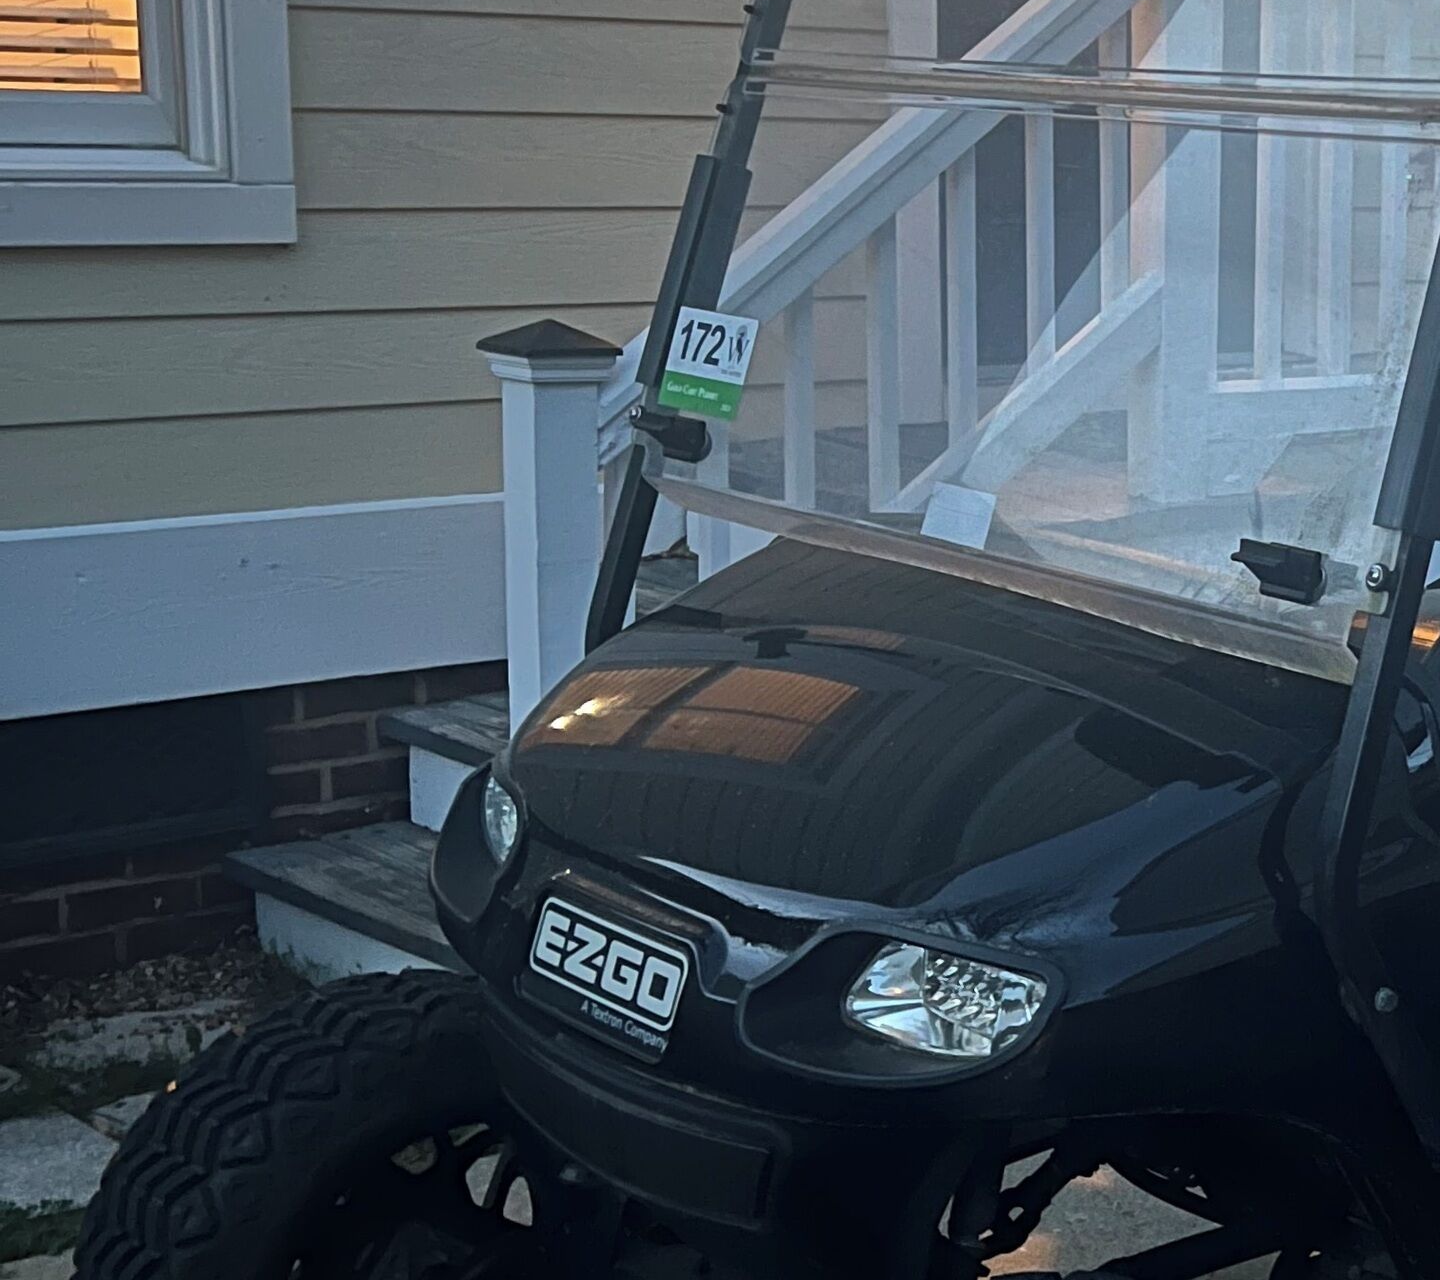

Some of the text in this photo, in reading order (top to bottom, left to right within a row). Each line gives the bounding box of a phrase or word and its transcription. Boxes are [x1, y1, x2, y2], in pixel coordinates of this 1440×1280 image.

[680, 319, 726, 367] 172
[580, 999, 669, 1053] A Textron Company
